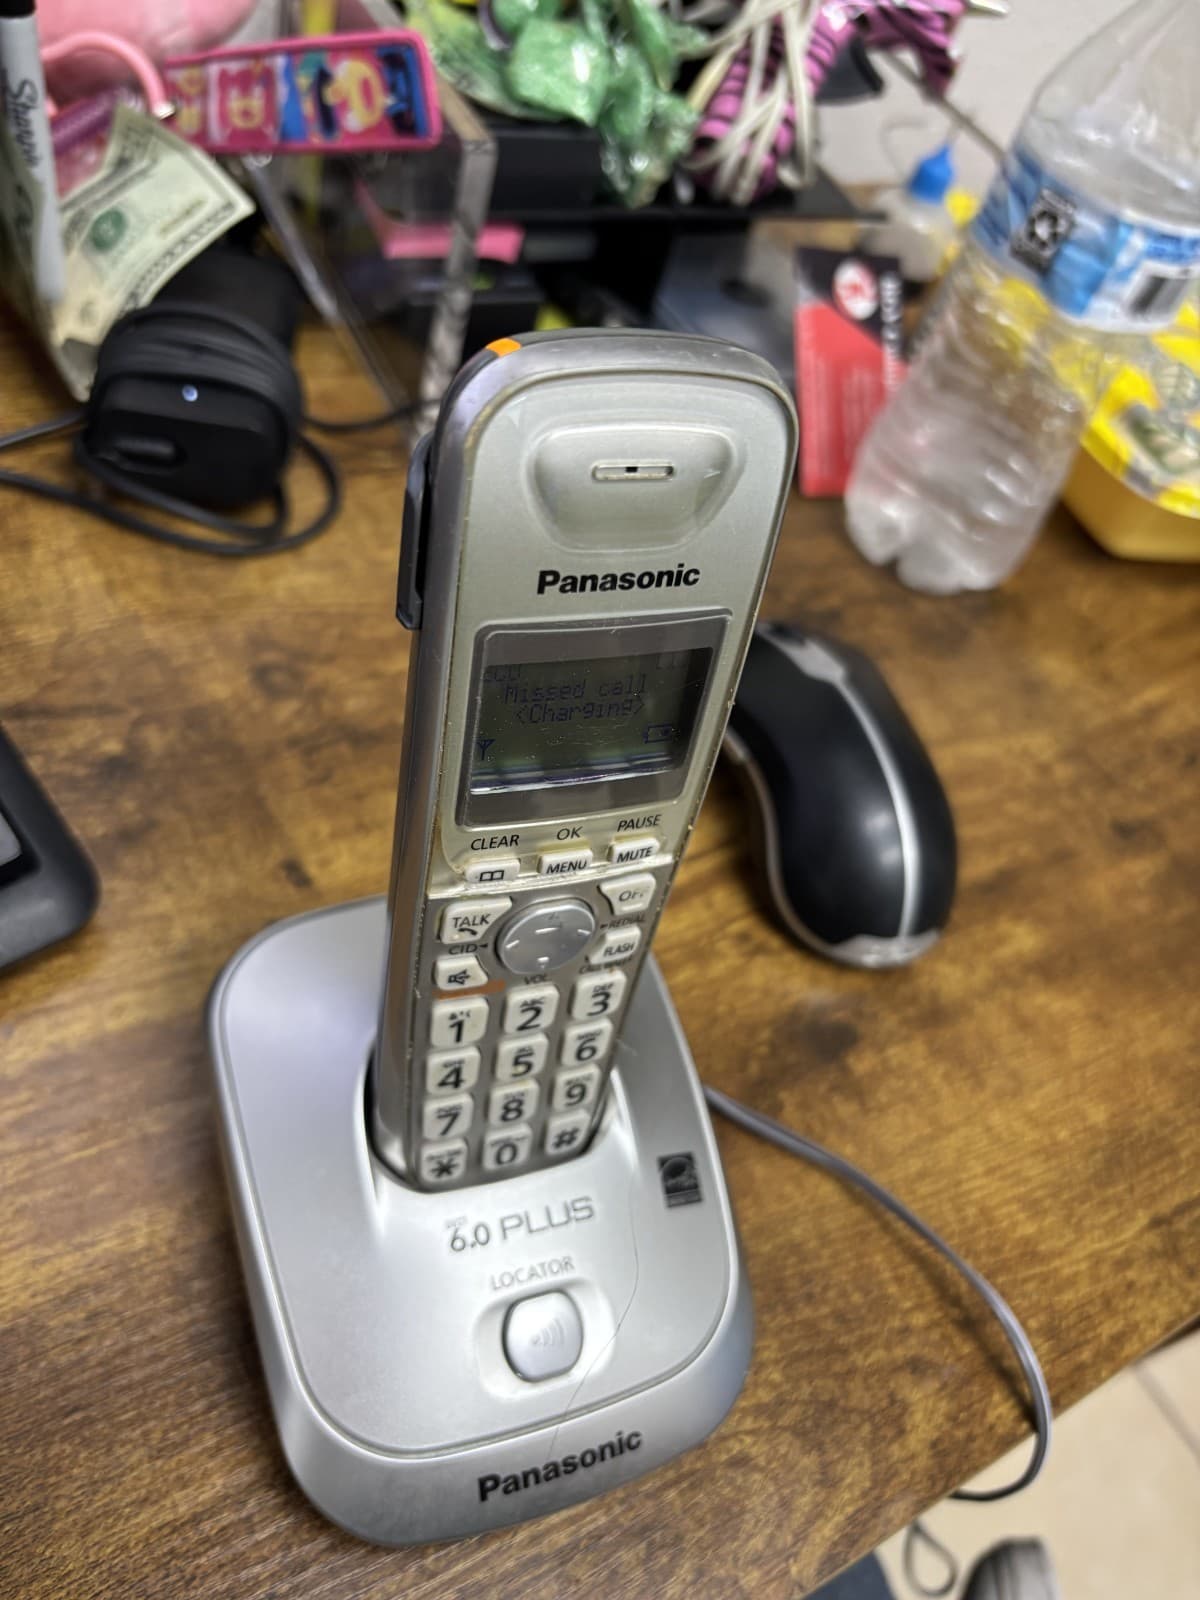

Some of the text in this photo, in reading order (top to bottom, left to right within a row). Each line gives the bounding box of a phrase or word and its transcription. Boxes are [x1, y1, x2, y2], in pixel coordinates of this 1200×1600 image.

[537, 563, 701, 595] Panasonic
[503, 673, 647, 703] Missed call
[556, 826, 582, 840] OK
[617, 814, 662, 832] PAUSE
[470, 834, 520, 851] CLEAR
[546, 859, 588, 875] MENU
[616, 847, 654, 864] MUTE
[452, 913, 491, 928] TALK
[448, 943, 478, 956] CID
[603, 942, 636, 957] FLASH
[524, 974, 548, 985] VOL
[586, 991, 611, 1016] 3
[516, 1006, 542, 1031] 2
[449, 1020, 464, 1043] 1
[576, 1037, 597, 1061] 6
[511, 1052, 534, 1077] 5
[437, 1065, 465, 1089] 4
[565, 1083, 587, 1106] 9
[501, 1099, 524, 1122] 8
[436, 1111, 460, 1136] 7
[552, 1127, 580, 1149] #
[495, 1142, 518, 1165] 0
[450, 1195, 595, 1252] 6.0 PLUS
[490, 1256, 575, 1291] LOCATOR
[476, 1428, 644, 1503] Panasonic
